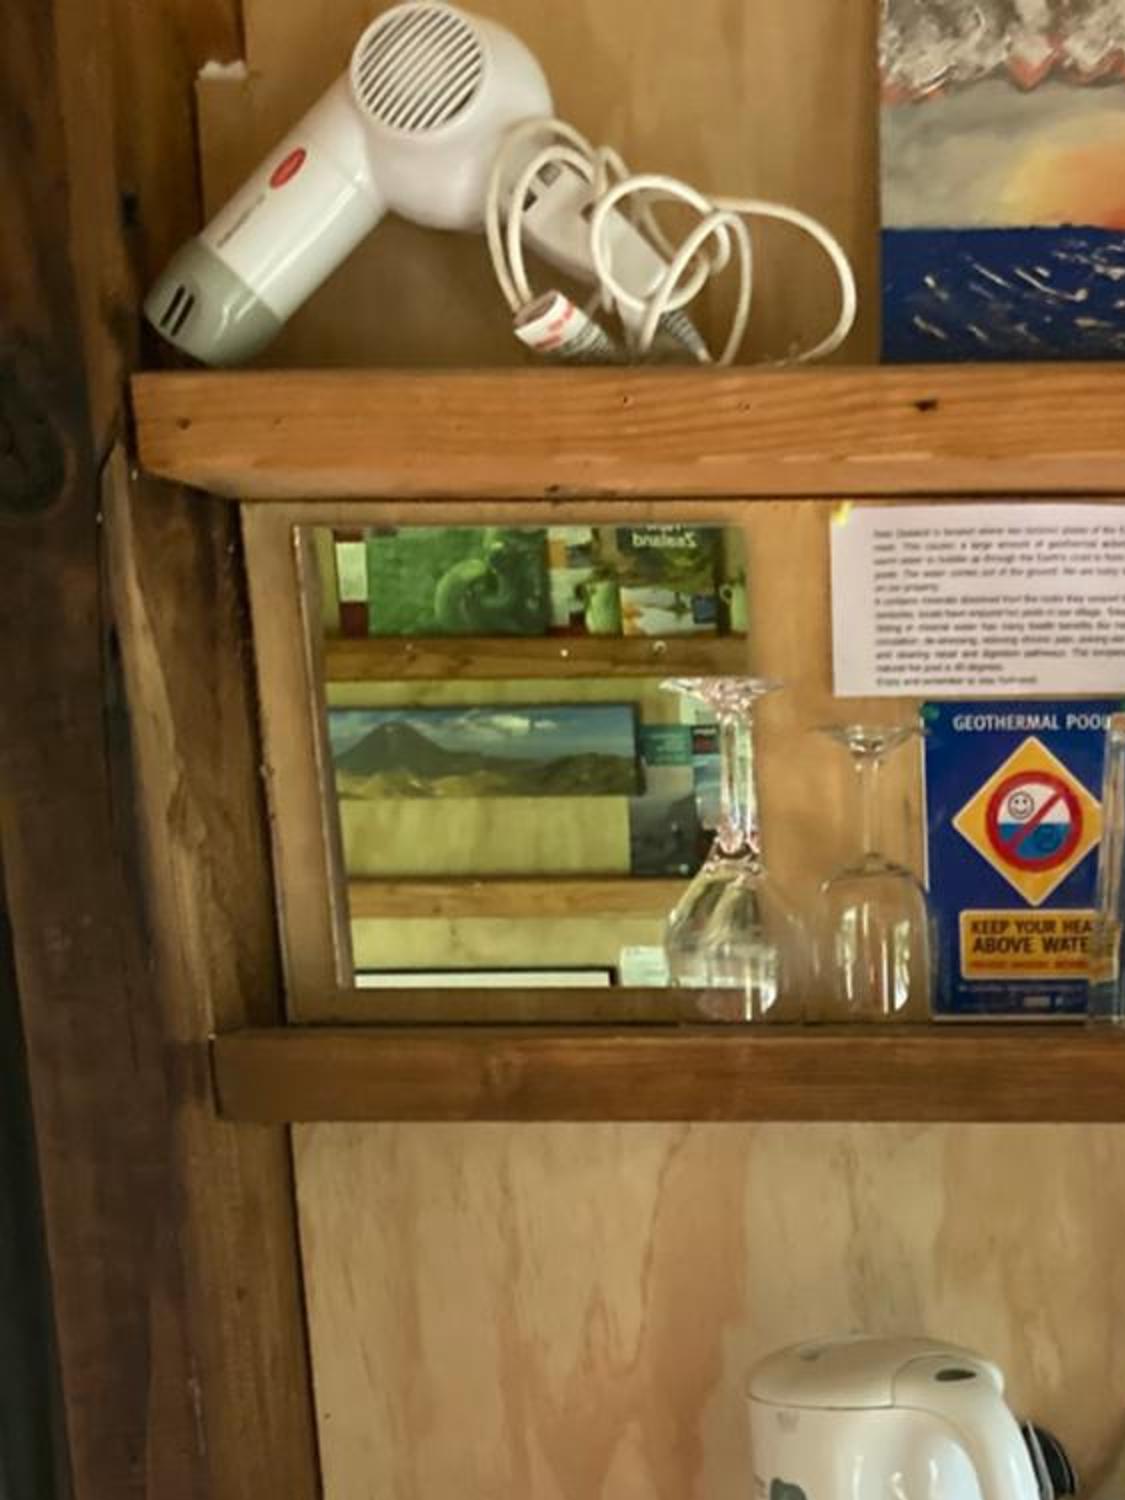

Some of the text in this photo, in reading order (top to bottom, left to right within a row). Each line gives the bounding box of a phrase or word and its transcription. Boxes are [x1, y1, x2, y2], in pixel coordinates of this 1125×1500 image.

[952, 714, 1059, 731] GEOTHERMAL
[971, 919, 1094, 934] KEEP YOUR HEA
[973, 936, 1089, 954] ABOVE WATE
